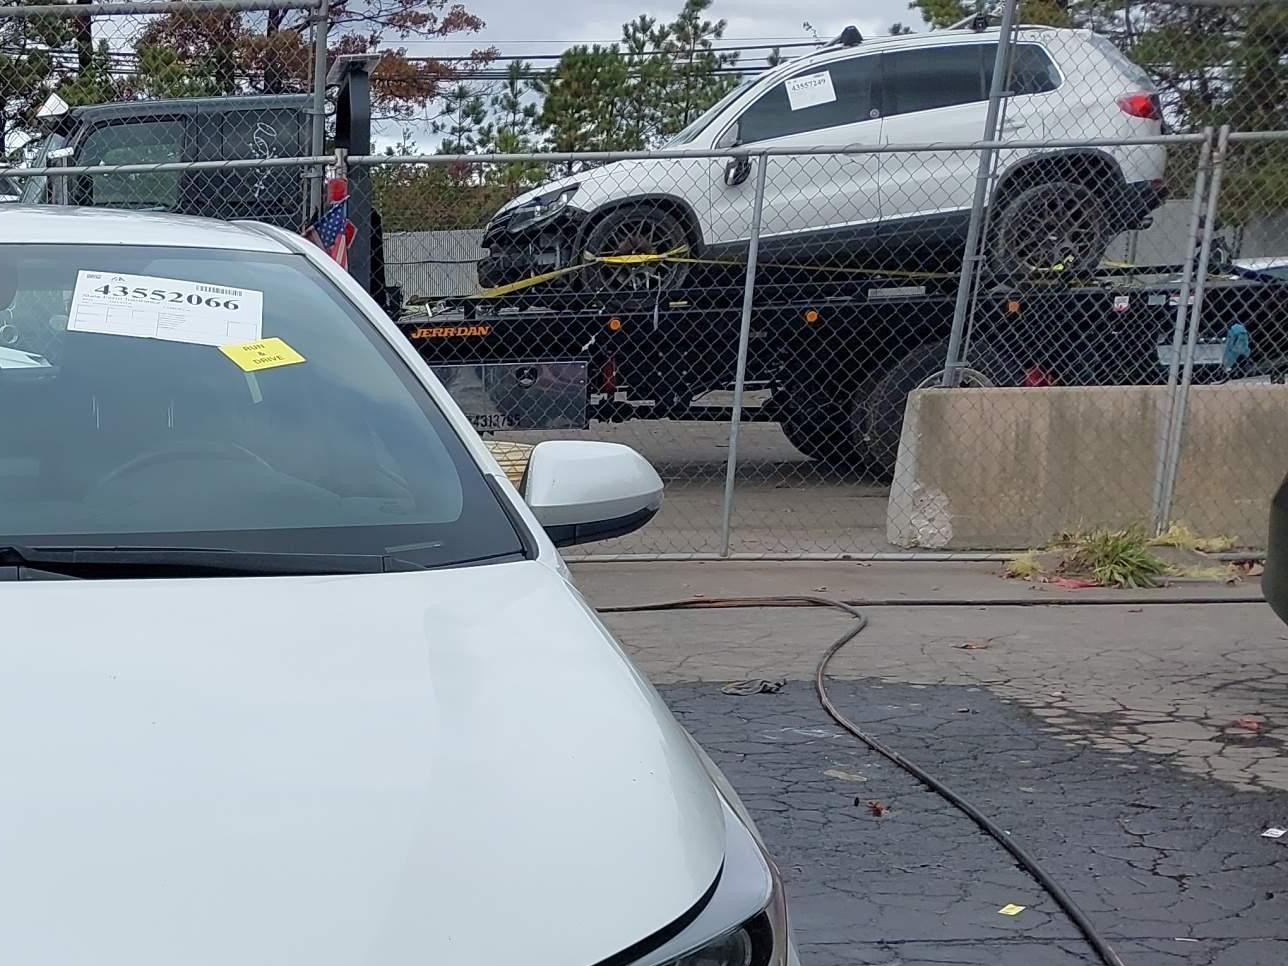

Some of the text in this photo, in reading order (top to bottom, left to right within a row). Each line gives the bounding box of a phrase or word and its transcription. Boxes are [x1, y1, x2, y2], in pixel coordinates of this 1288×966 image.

[94, 284, 239, 310] 43552066
[242, 343, 265, 351] RUN
[252, 355, 284, 364] DRIVE
